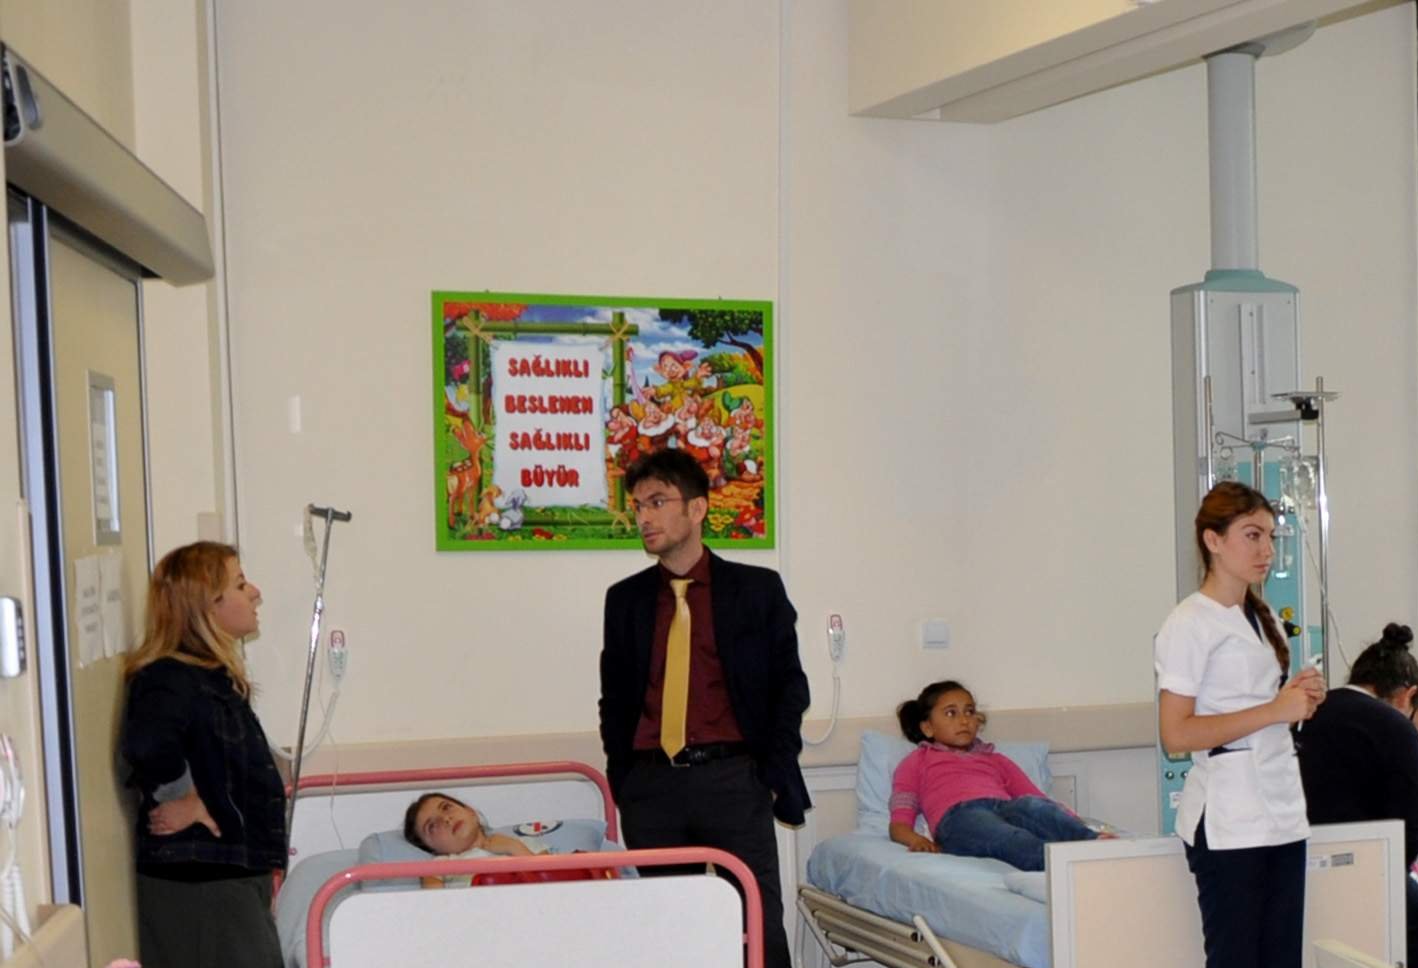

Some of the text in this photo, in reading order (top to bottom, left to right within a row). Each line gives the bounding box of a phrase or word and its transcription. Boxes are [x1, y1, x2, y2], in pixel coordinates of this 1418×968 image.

[507, 355, 590, 379] SAĞLIKLI
[503, 394, 594, 415] BESLENEN
[508, 429, 590, 452] SAĞLIKLI
[520, 465, 580, 488] BÜYÜR
